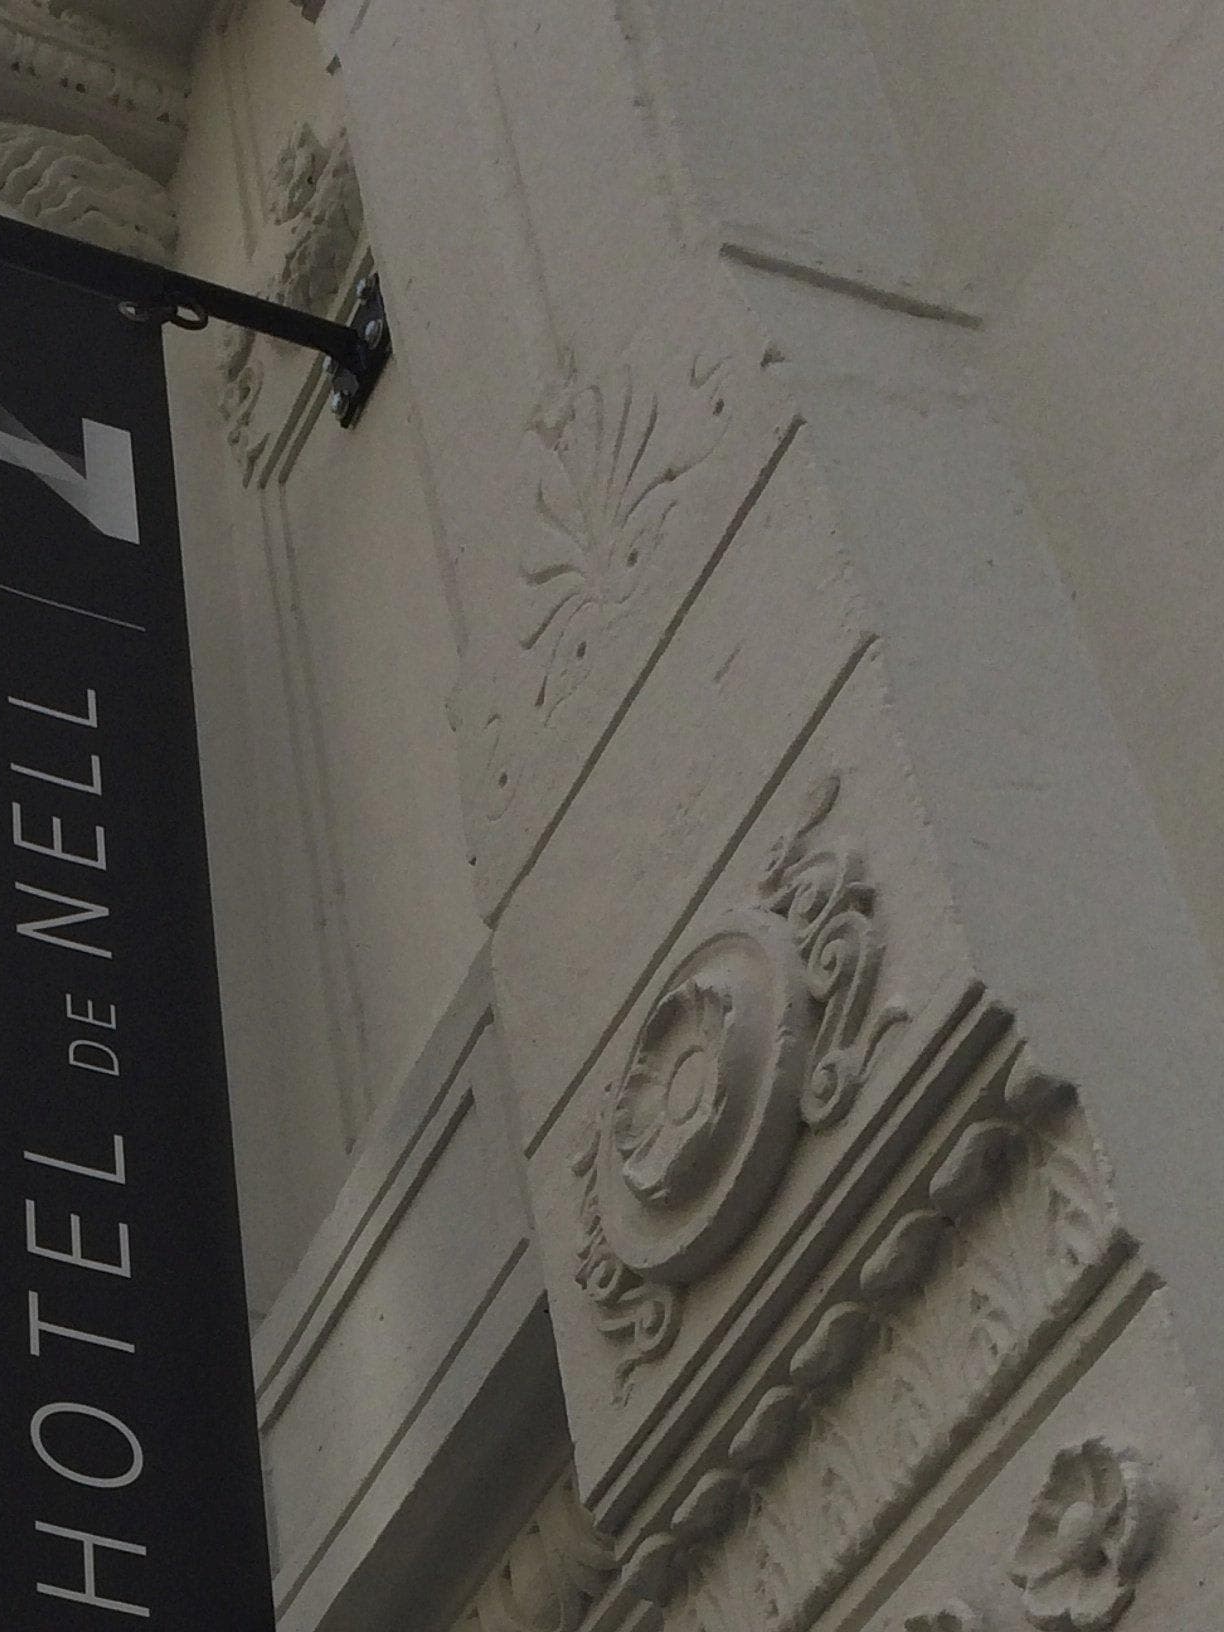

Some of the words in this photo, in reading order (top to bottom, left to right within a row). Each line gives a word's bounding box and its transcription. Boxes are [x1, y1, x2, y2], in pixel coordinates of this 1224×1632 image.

[7, 688, 112, 959] NELL
[65, 993, 120, 1077] DE
[23, 1134, 150, 1618] HOTEL
